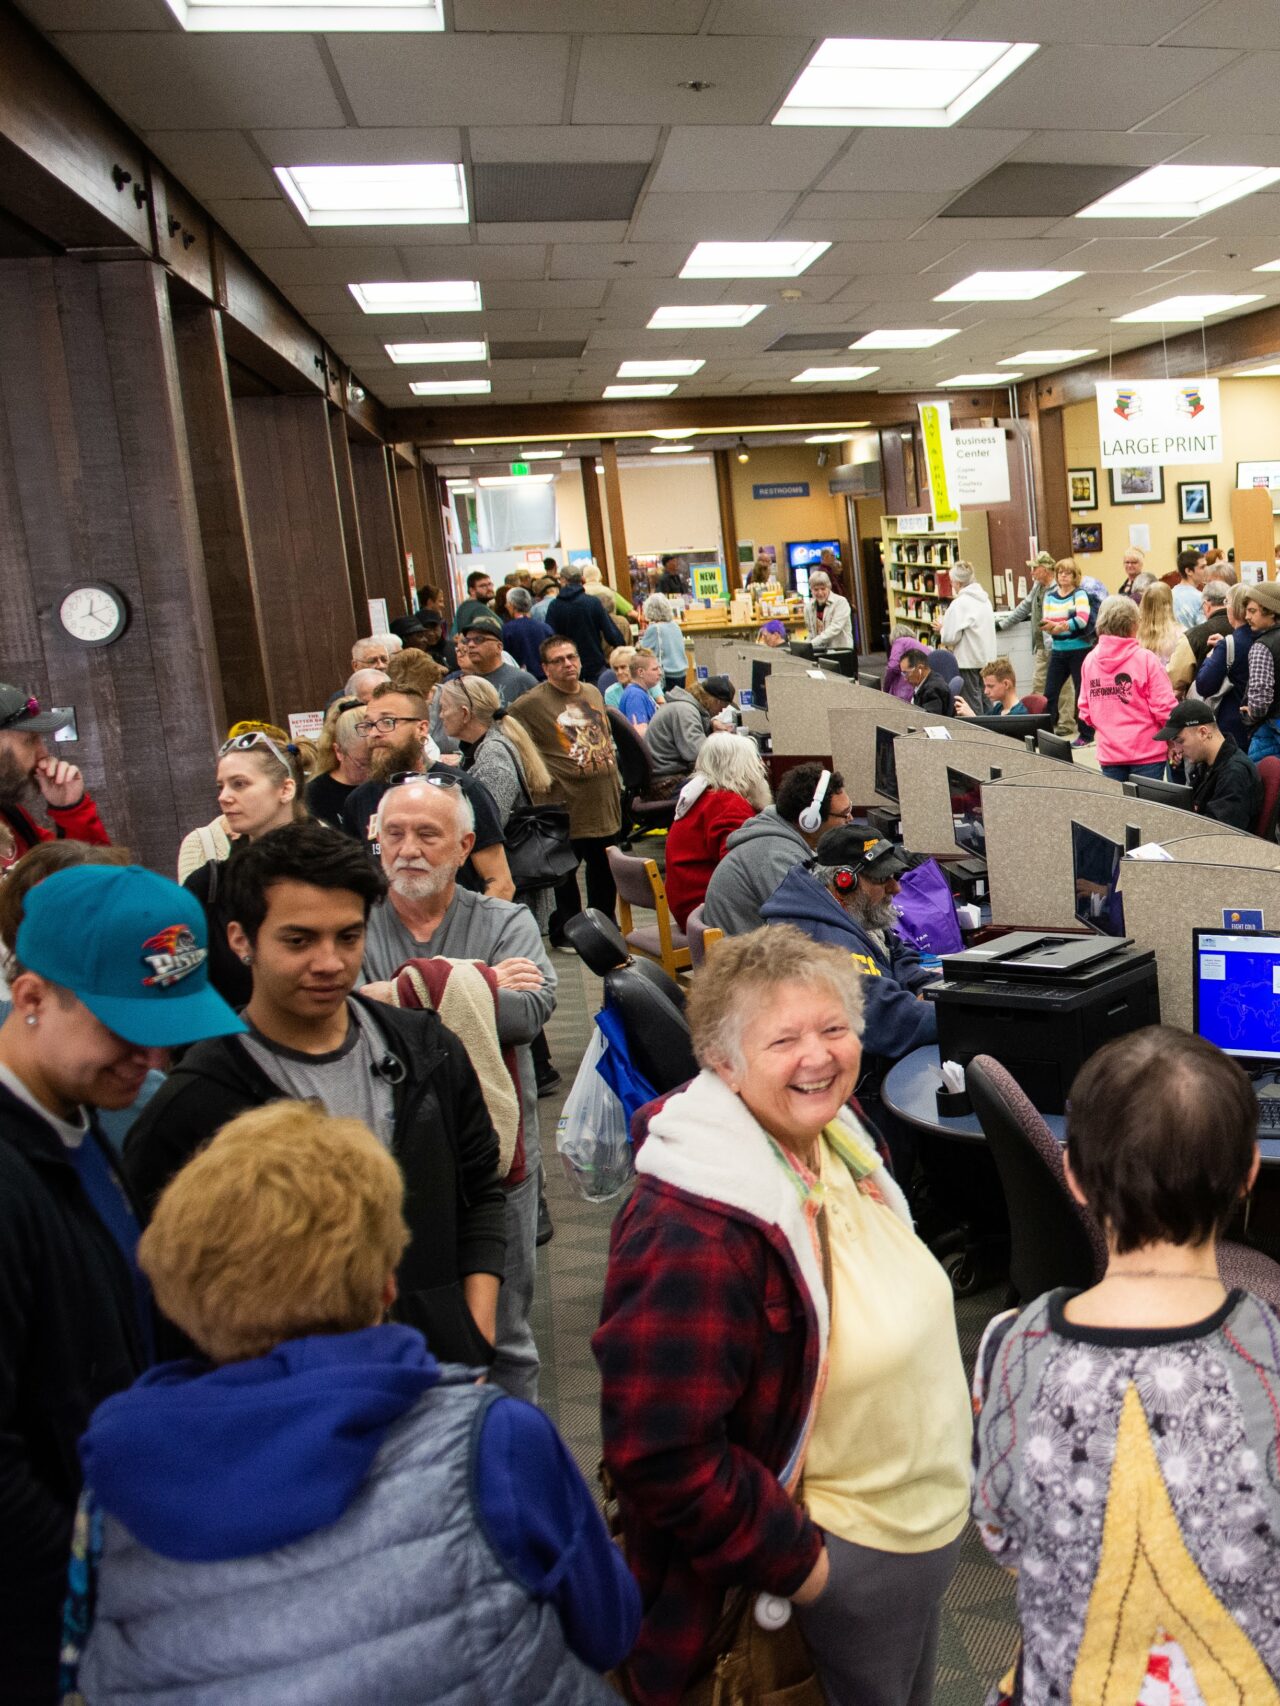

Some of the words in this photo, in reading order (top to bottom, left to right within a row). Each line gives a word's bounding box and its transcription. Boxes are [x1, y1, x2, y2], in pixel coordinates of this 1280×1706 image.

[955, 436, 997, 446] Business
[1103, 438, 1160, 456] LARGE
[1165, 435, 1217, 453] PRINT
[956, 449, 990, 459] Center
[759, 486, 803, 495] RESTROOMS
[699, 572, 716, 581] NEW
[700, 585, 718, 595] BOOKS
